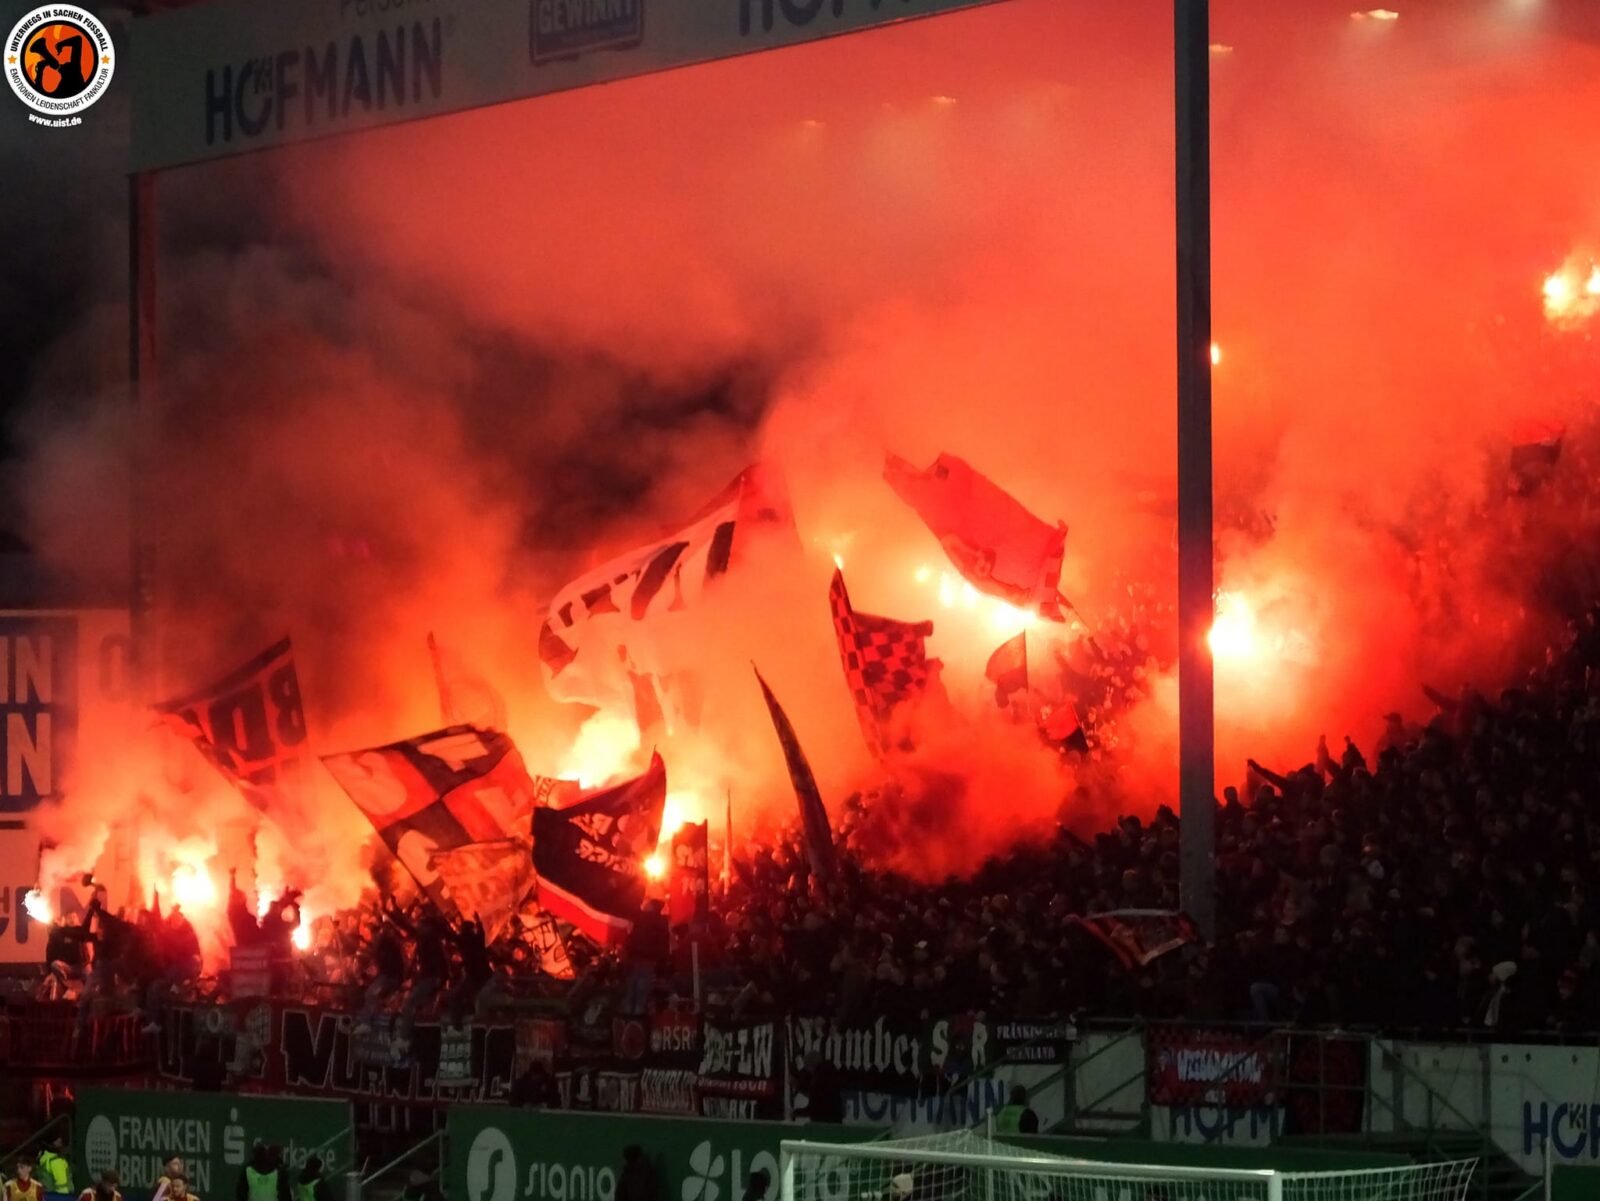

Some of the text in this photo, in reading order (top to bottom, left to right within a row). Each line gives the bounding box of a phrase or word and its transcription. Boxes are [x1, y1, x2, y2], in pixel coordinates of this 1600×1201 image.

[206, 16, 441, 147] HOFMANN
[0, 712, 51, 796] N
[795, 1015, 920, 1079] Bamber
[119, 1115, 210, 1154] FRANKEN
[119, 1154, 210, 1192] BRUEN
